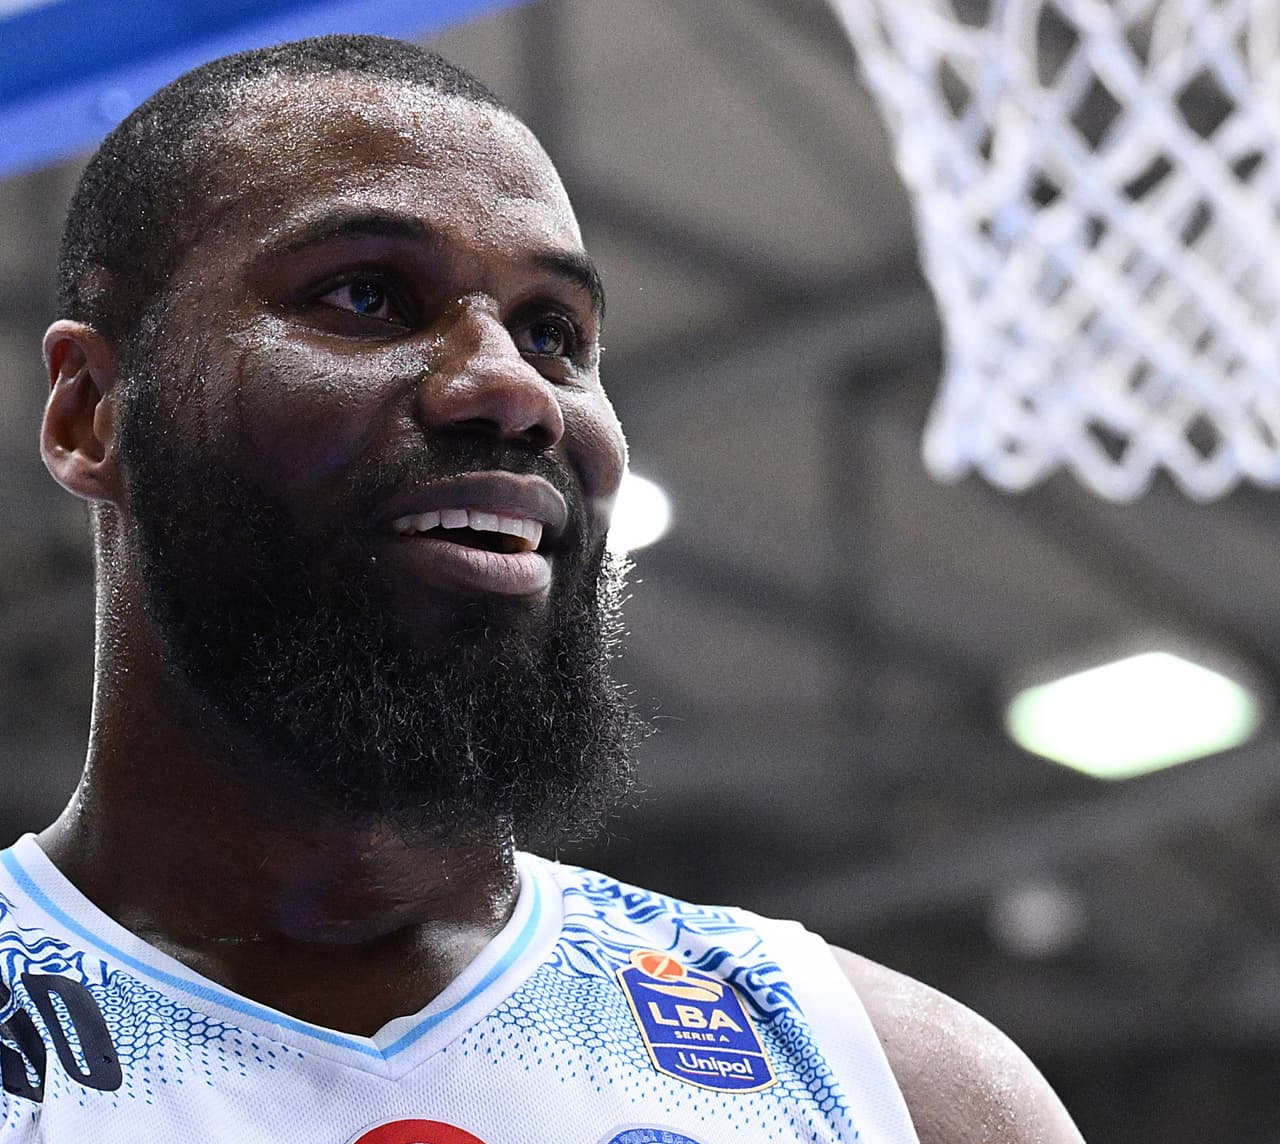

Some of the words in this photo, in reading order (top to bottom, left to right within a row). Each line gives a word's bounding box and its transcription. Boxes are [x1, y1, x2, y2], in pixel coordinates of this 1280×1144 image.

[648, 1002, 743, 1033] LBA
[674, 1030, 715, 1042] SERIE
[719, 1033, 730, 1043] A
[678, 1052, 752, 1077] Unipol
